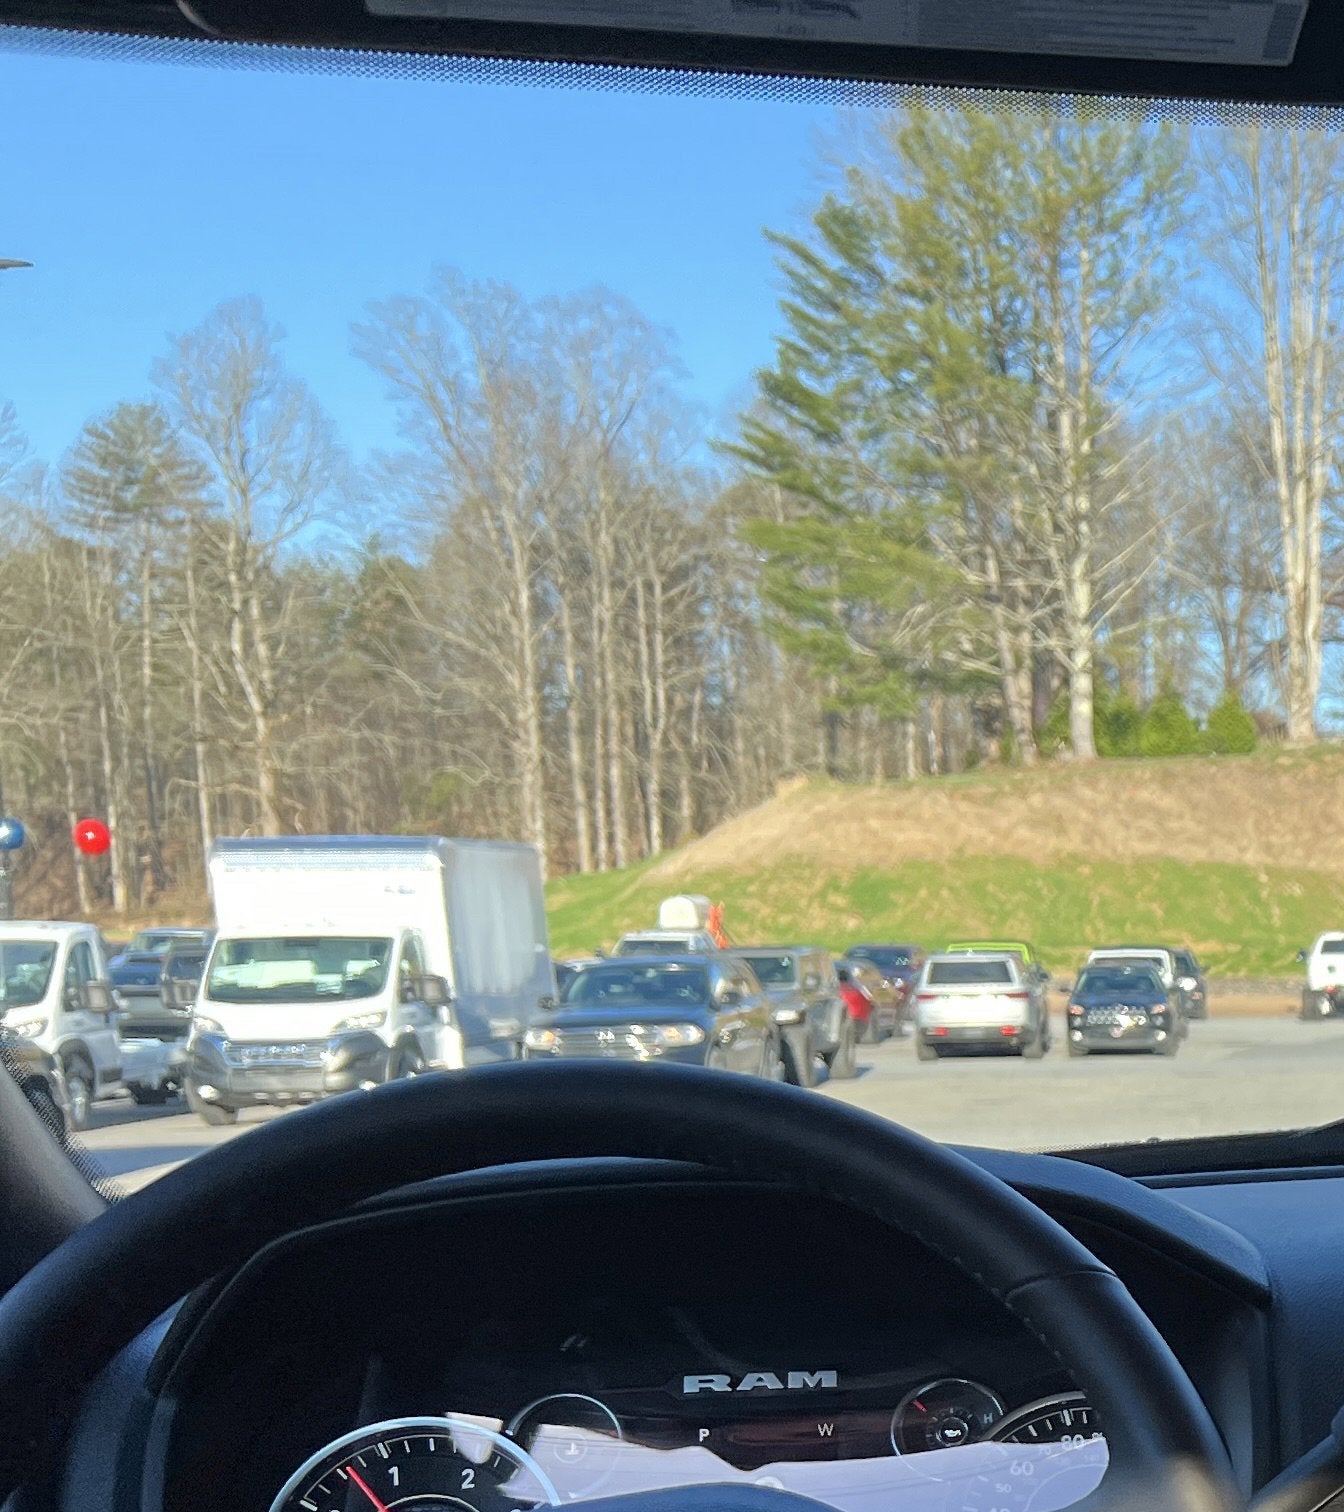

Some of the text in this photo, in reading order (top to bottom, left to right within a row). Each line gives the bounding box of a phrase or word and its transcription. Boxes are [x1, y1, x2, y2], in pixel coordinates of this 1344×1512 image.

[683, 1370, 837, 1393] RAM
[699, 1429, 710, 1441] P
[818, 1423, 833, 1437] W
[1061, 1434, 1084, 1450] 80
[388, 1466, 399, 1486] 1
[1010, 1461, 1034, 1476] 60
[461, 1468, 475, 1489] 2
